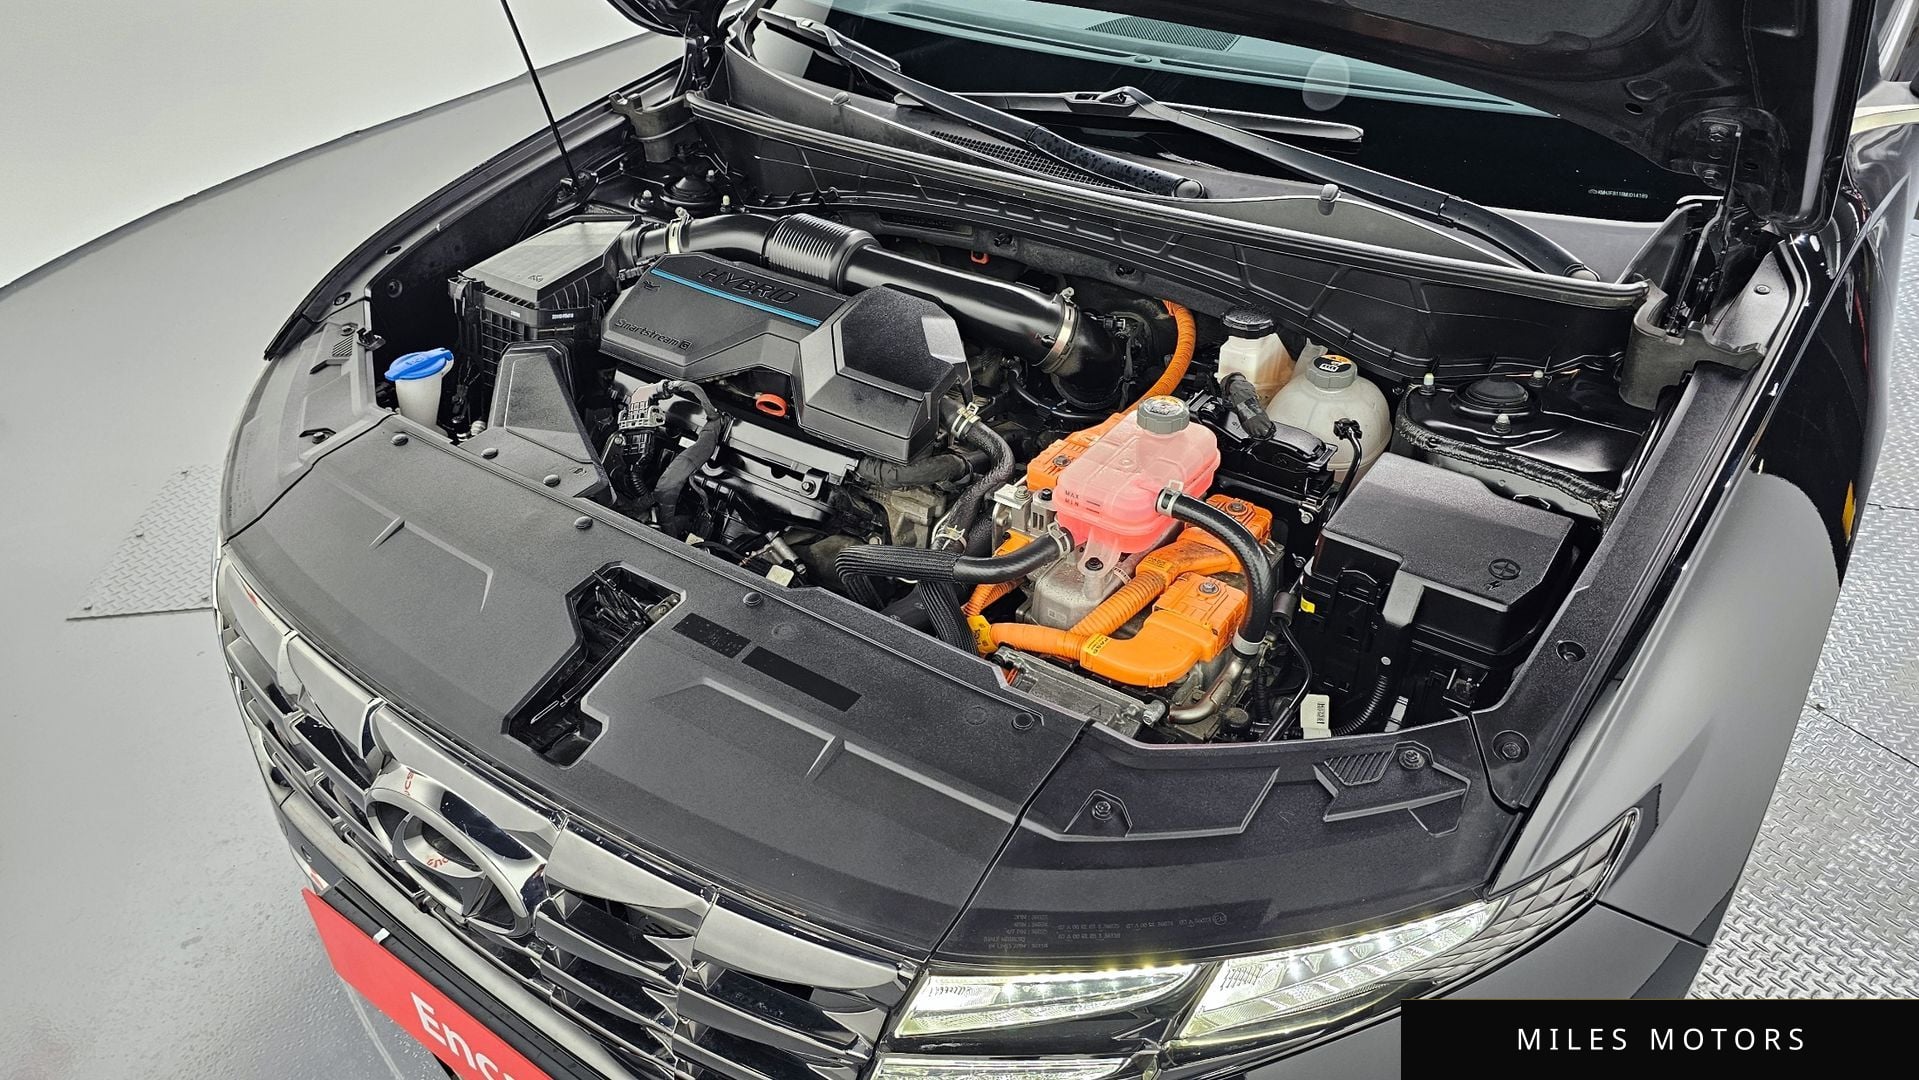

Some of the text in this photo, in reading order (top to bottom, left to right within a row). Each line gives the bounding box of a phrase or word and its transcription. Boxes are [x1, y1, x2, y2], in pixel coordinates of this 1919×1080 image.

[698, 268, 799, 304] HYBRID
[614, 318, 680, 347] Smartstream
[410, 991, 516, 1080] Enc
